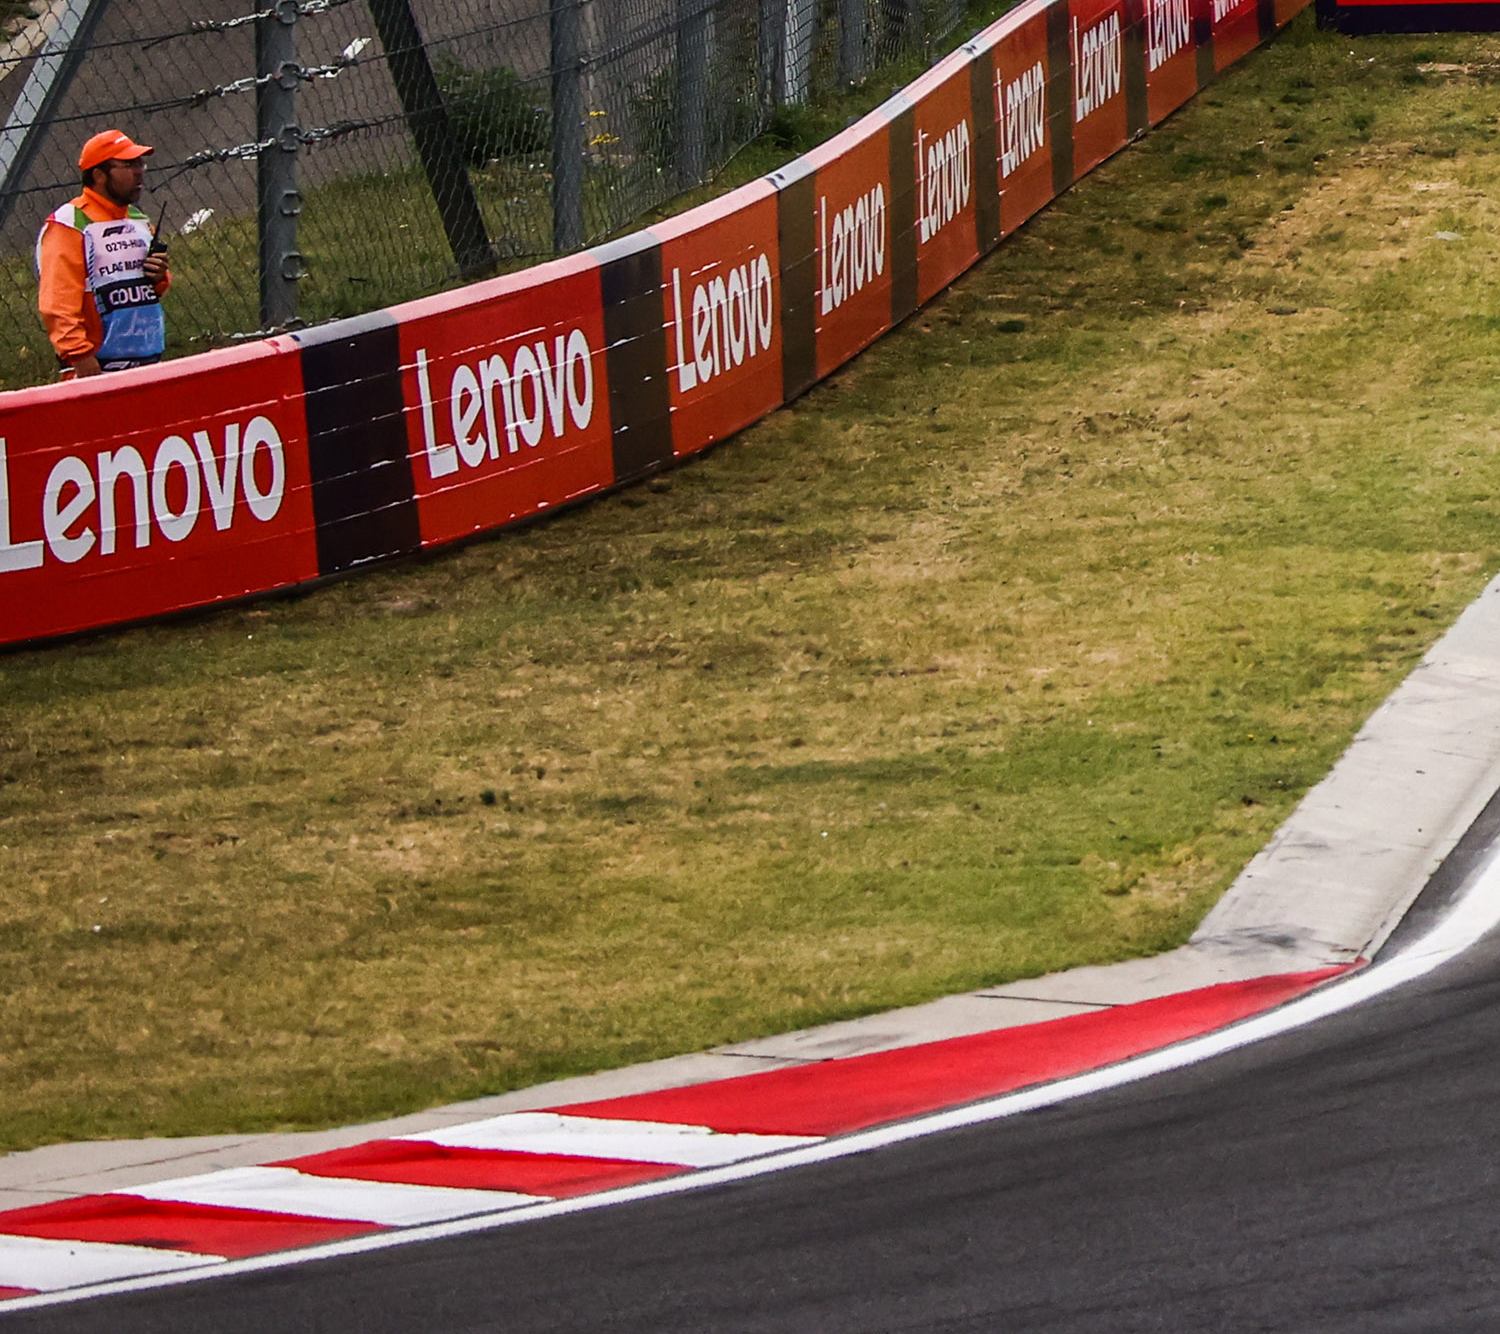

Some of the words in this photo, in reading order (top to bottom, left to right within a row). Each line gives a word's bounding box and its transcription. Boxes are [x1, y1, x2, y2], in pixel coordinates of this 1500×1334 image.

[997, 60, 1045, 179] Lenovo
[1074, 10, 1121, 124] Lenovo
[919, 118, 971, 244] Lenovo
[820, 182, 886, 316] Lenovo
[672, 252, 772, 394] Lenovo
[417, 328, 593, 479] Lenovo
[0, 415, 285, 572] Lenovo
